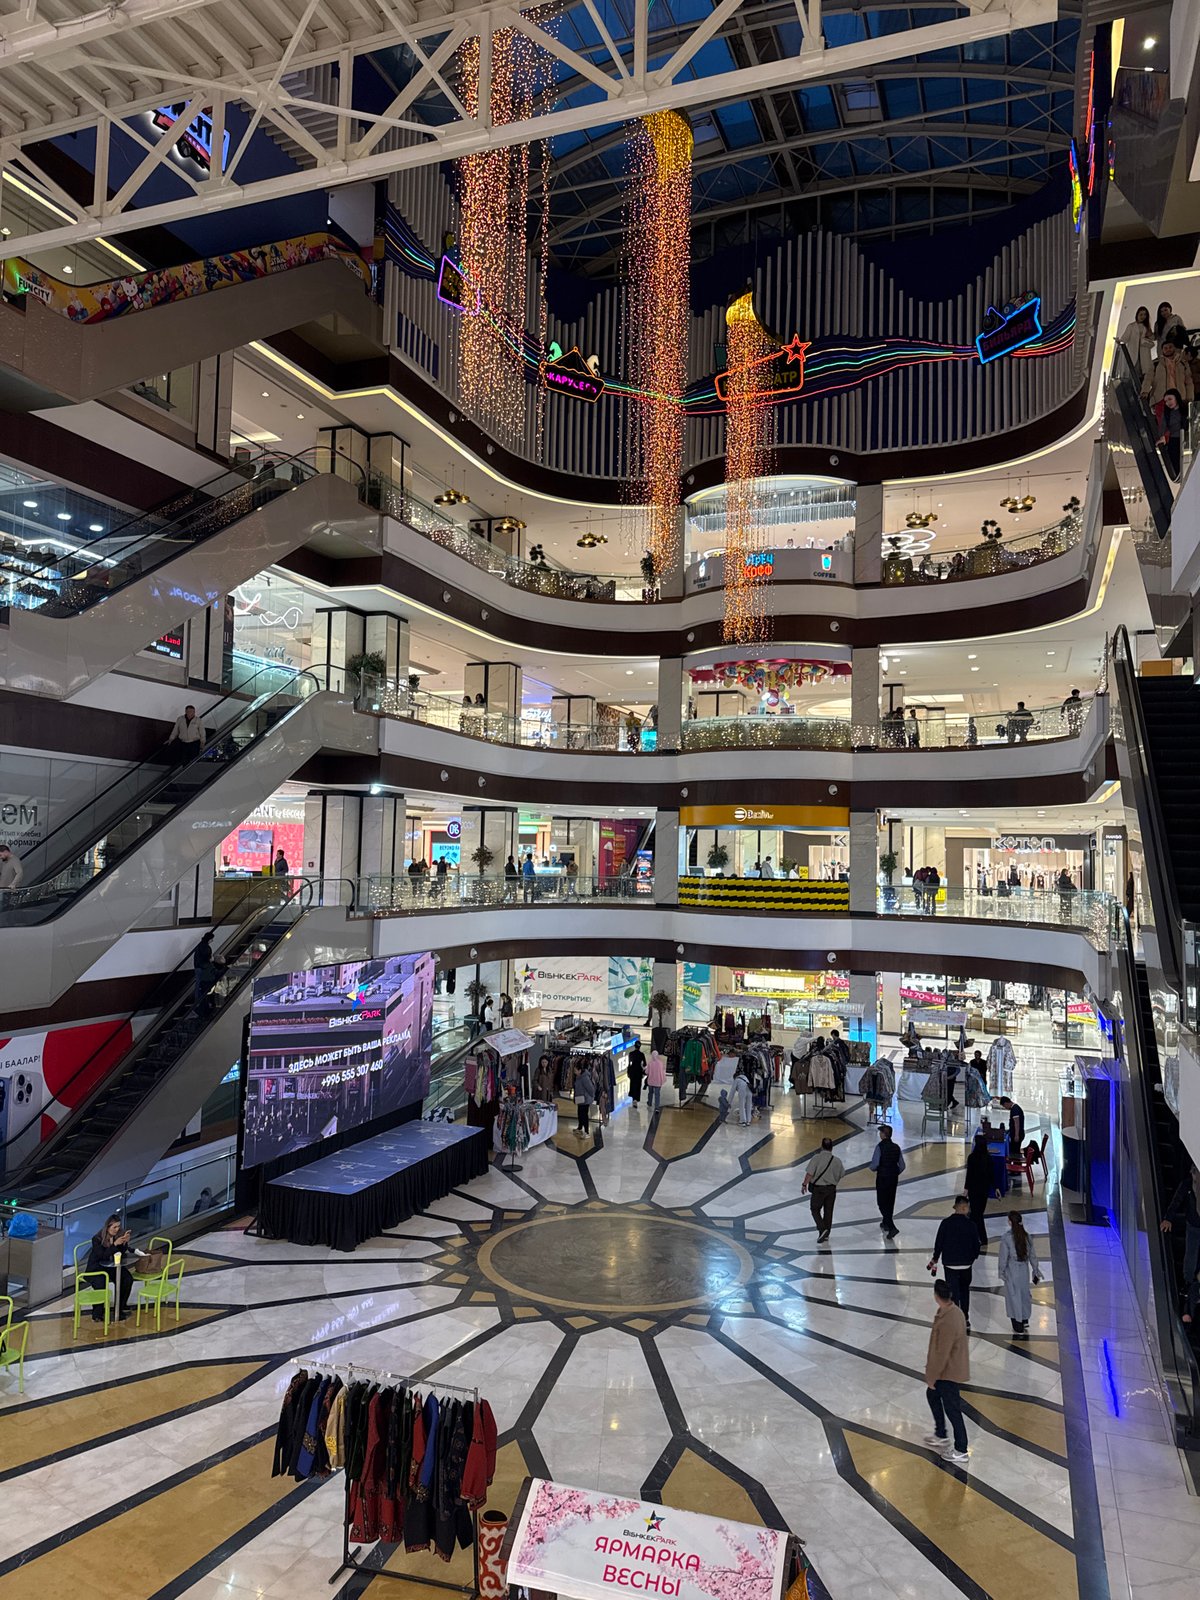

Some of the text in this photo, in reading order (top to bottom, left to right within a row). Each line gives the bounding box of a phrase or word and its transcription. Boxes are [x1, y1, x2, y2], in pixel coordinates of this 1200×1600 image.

[5, 1055, 41, 1069] БААЛАР!
[288, 1030, 412, 1074] ЗДЕСЬ МОЖЕТ БЫТЬ ВАША РЕКЛАМА
[321, 1058, 384, 1086] +996 555 307 460
[594, 1536, 701, 1572] ЯРМАРКА
[602, 1564, 682, 1597] ВЕСНЫ
